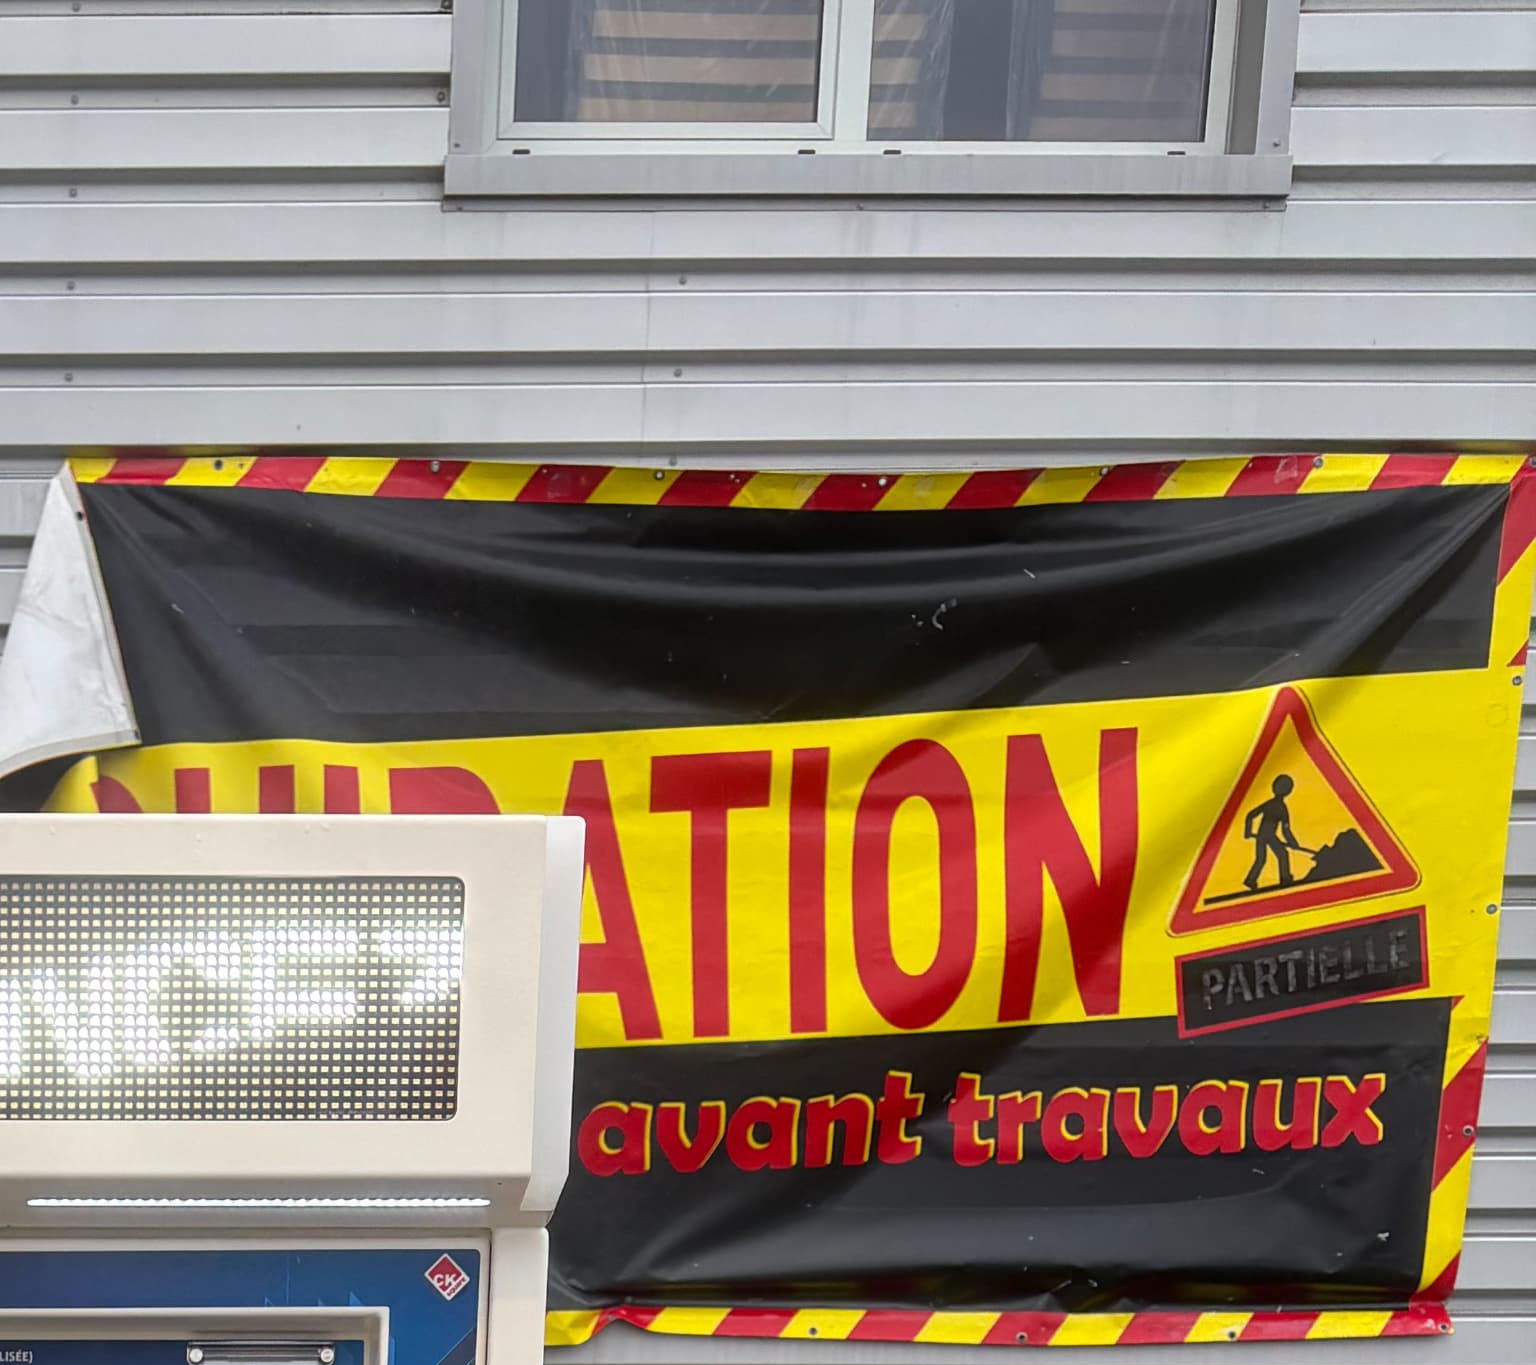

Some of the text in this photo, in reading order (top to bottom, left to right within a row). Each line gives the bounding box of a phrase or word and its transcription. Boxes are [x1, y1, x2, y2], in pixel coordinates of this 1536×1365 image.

[1201, 929, 1409, 1010] PARTIELLE
[577, 1070, 1385, 1176] avant travaux
[434, 1273, 457, 1287] CK
